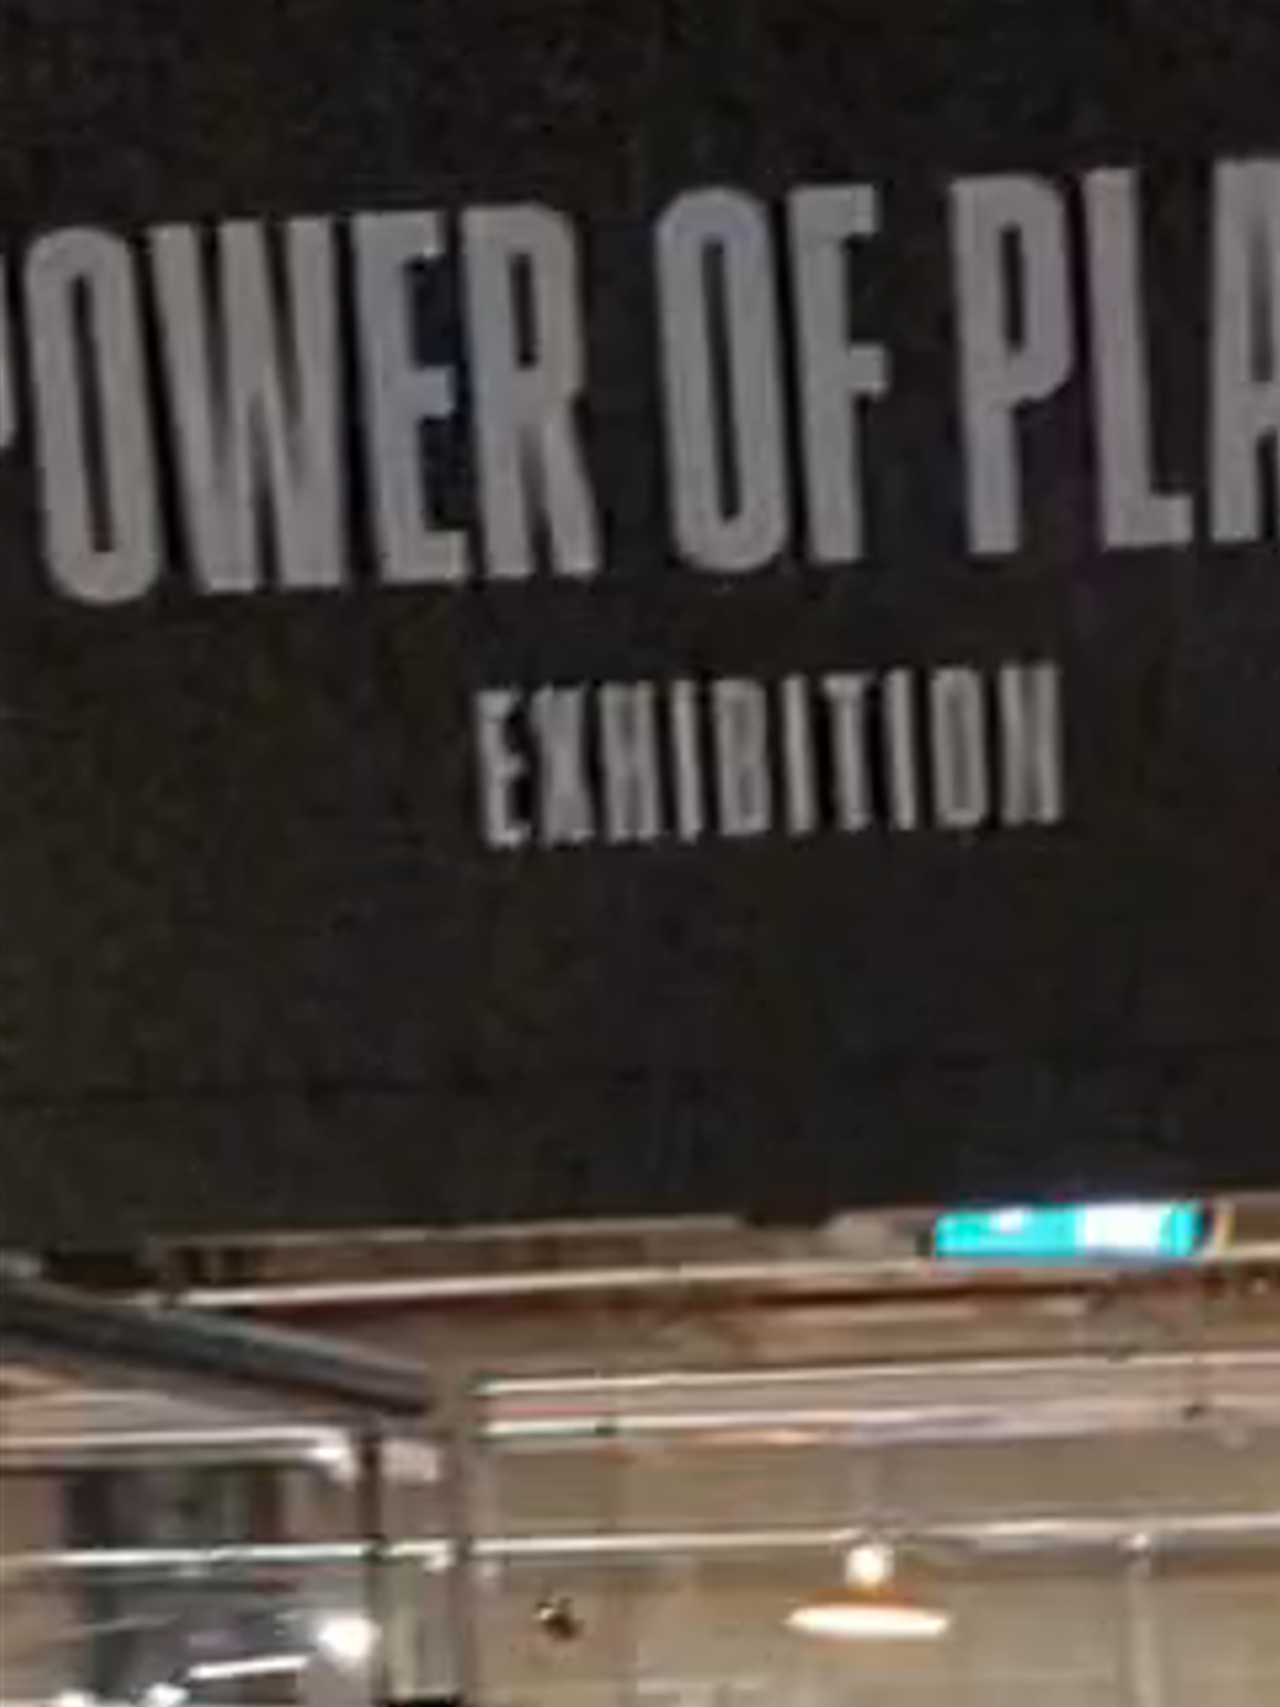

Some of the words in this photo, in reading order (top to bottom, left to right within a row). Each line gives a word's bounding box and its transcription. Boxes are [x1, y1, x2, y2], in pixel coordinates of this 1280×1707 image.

[0, 203, 600, 604] OWER
[655, 183, 892, 575] OF
[476, 663, 1066, 850] EXHIBITION
